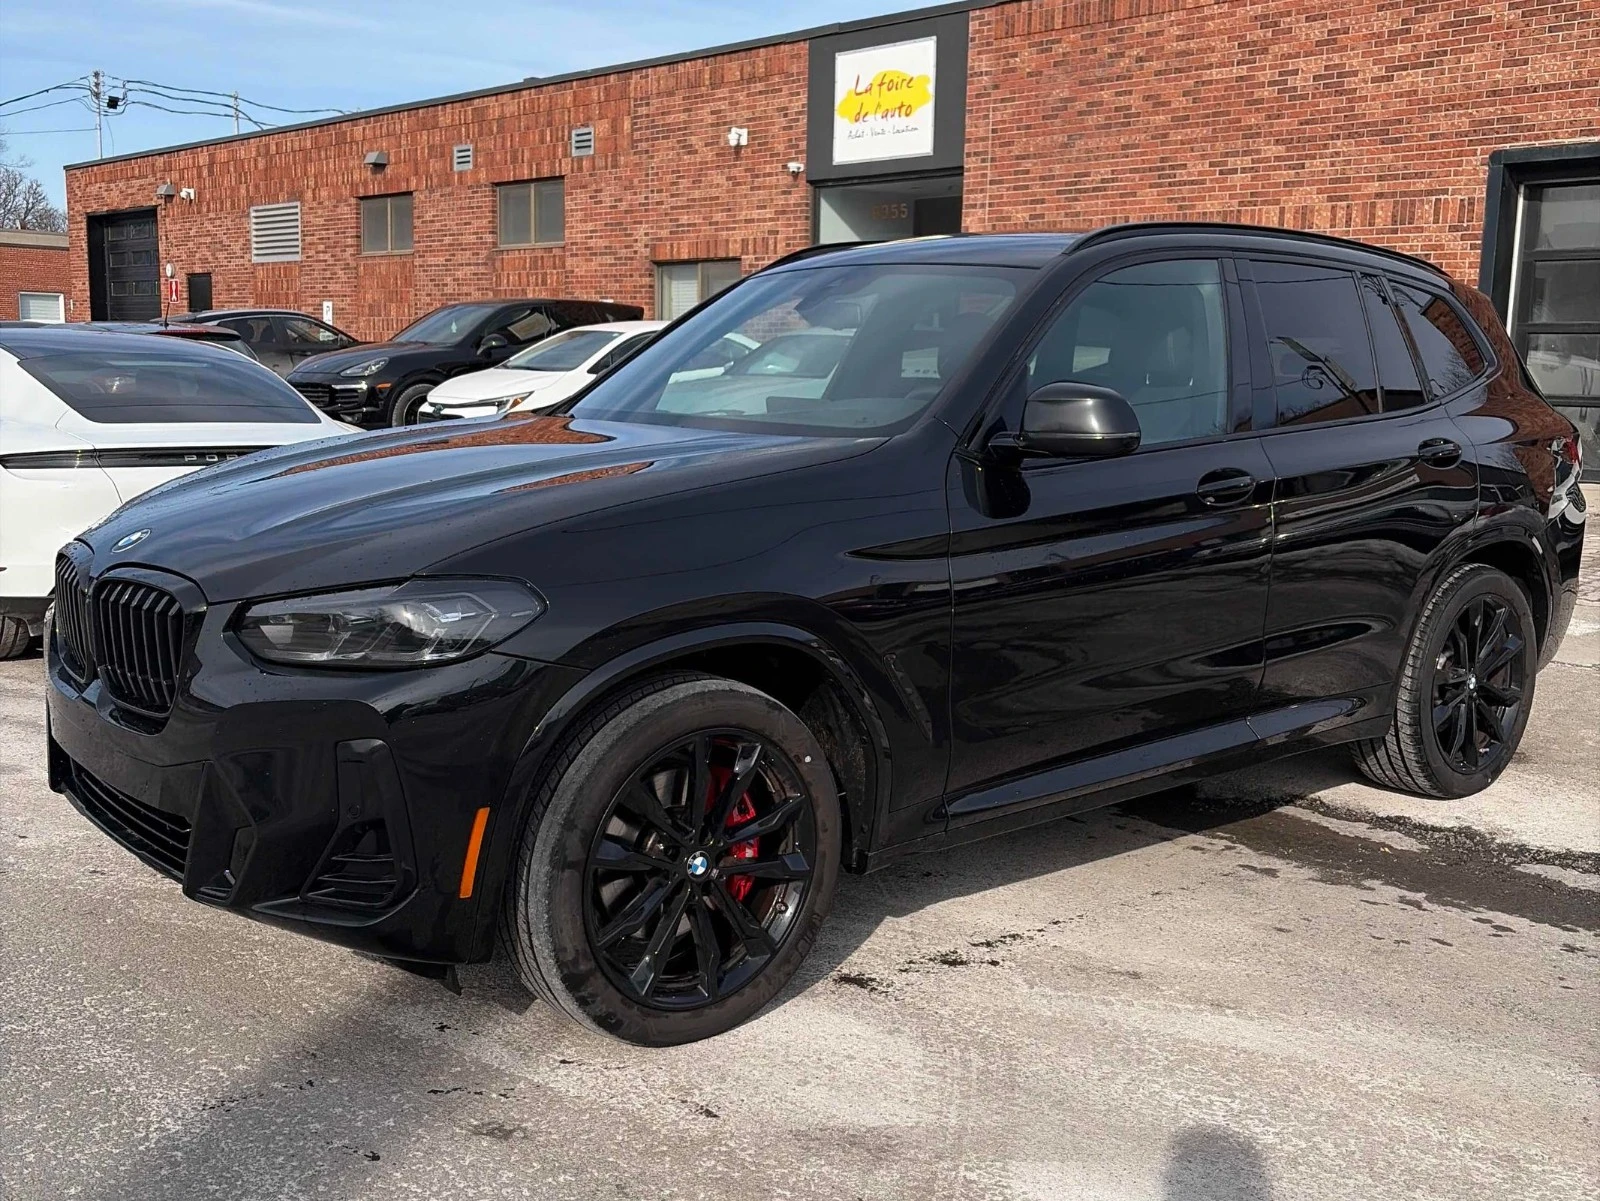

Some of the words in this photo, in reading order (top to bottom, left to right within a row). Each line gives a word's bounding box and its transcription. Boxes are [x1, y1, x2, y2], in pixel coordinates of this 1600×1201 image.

[855, 74, 873, 96] La
[877, 73, 914, 98] foire
[854, 102, 869, 123] de
[874, 101, 912, 121] l'auto
